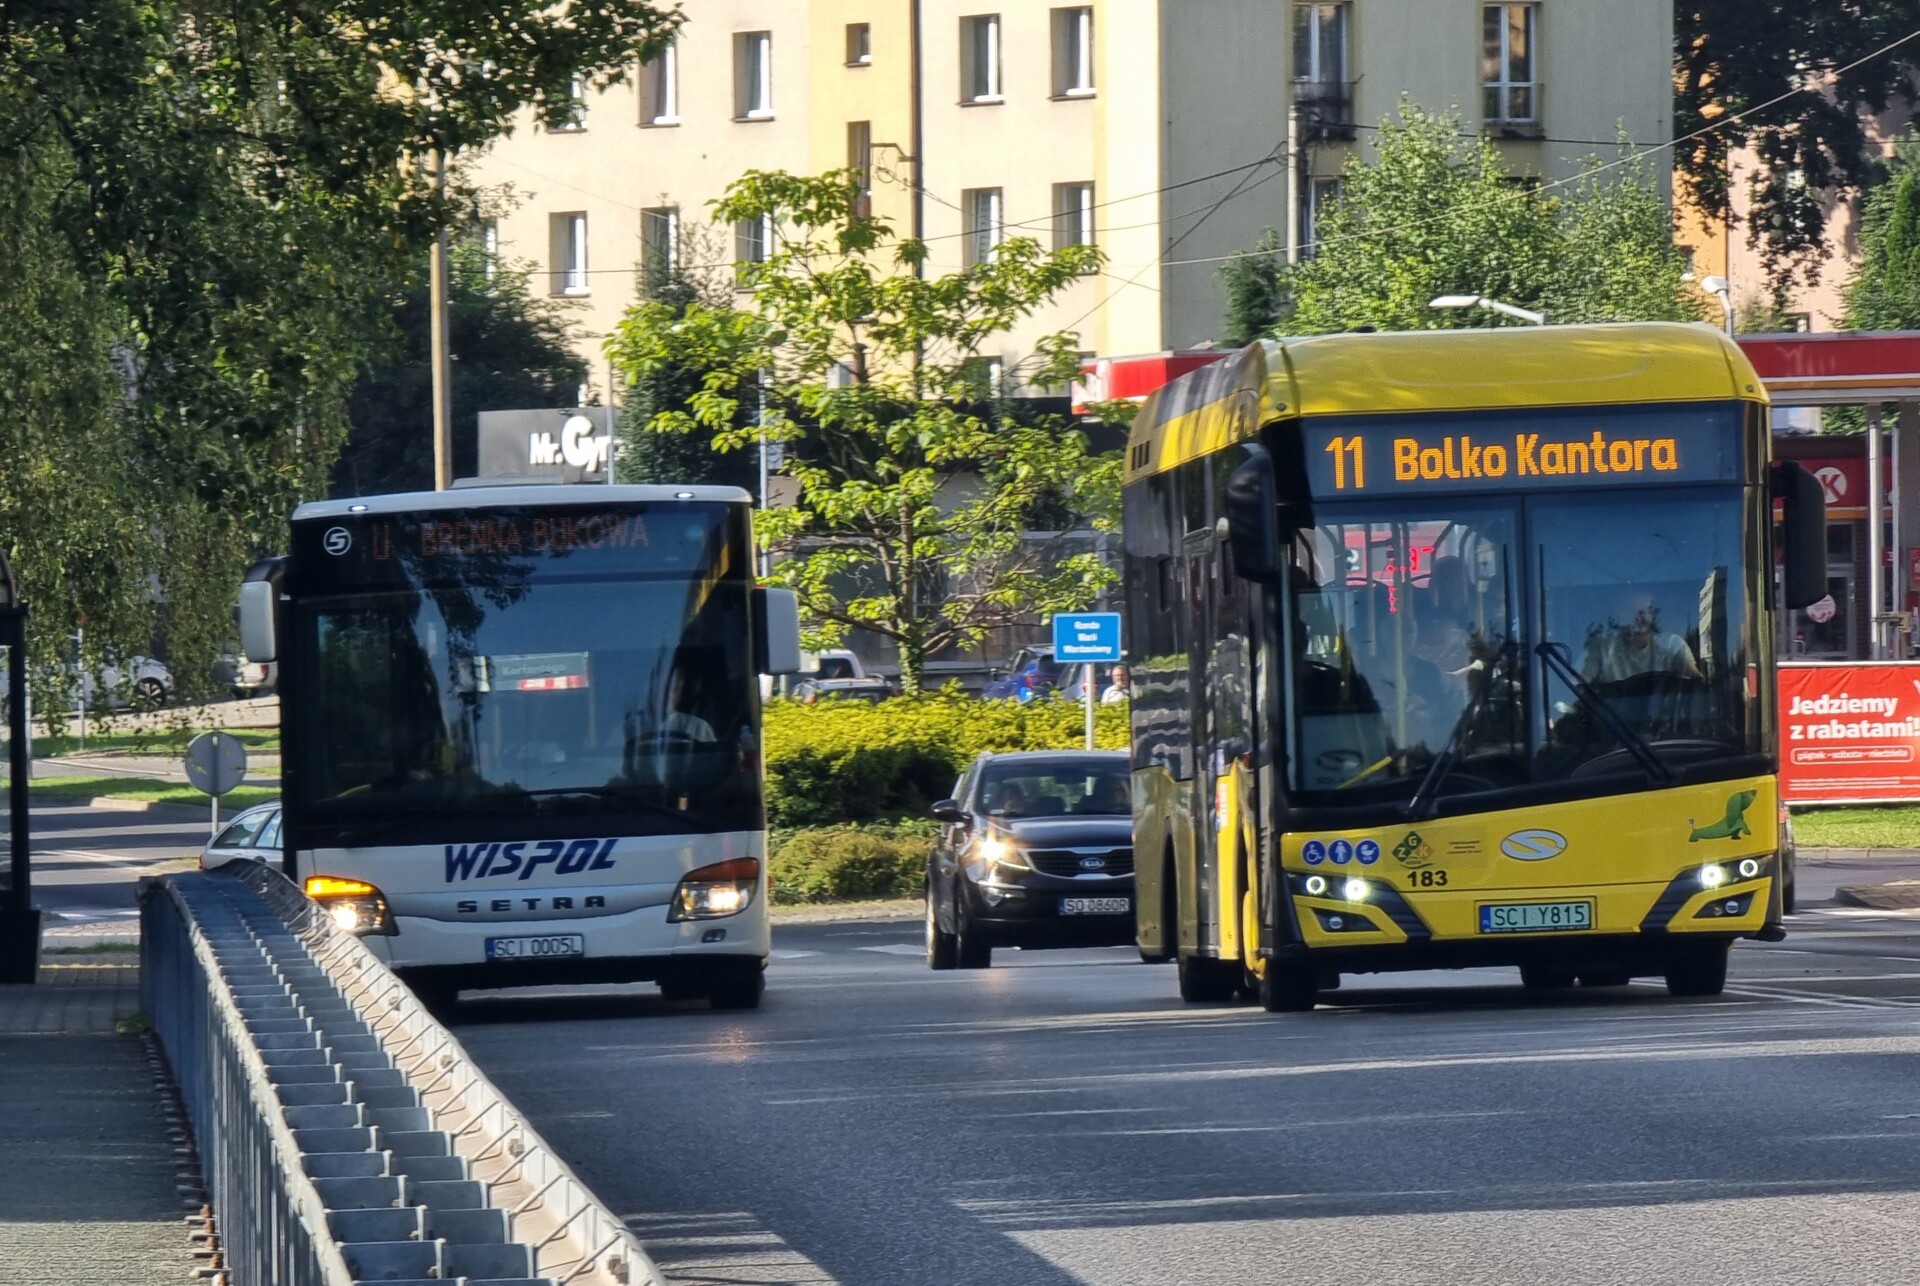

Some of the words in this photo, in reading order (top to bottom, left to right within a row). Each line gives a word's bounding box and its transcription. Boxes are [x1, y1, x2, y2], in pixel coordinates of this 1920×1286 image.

[1325, 435, 1364, 489] 11
[1393, 435, 1508, 481] Bolko
[1515, 431, 1678, 476] Kantora
[532, 514, 649, 552] BUKOWA
[1788, 692, 1899, 717] Jedziemy
[1789, 724, 1805, 740] z
[1806, 716, 1920, 740] rabatami!
[445, 838, 619, 883] WISPOL
[1407, 870, 1448, 887] 183
[456, 895, 606, 914] SETRA
[1494, 907, 1527, 926] SCI
[1538, 905, 1585, 925] Y815
[495, 938, 524, 957] SCI
[531, 937, 580, 955] 0005L
